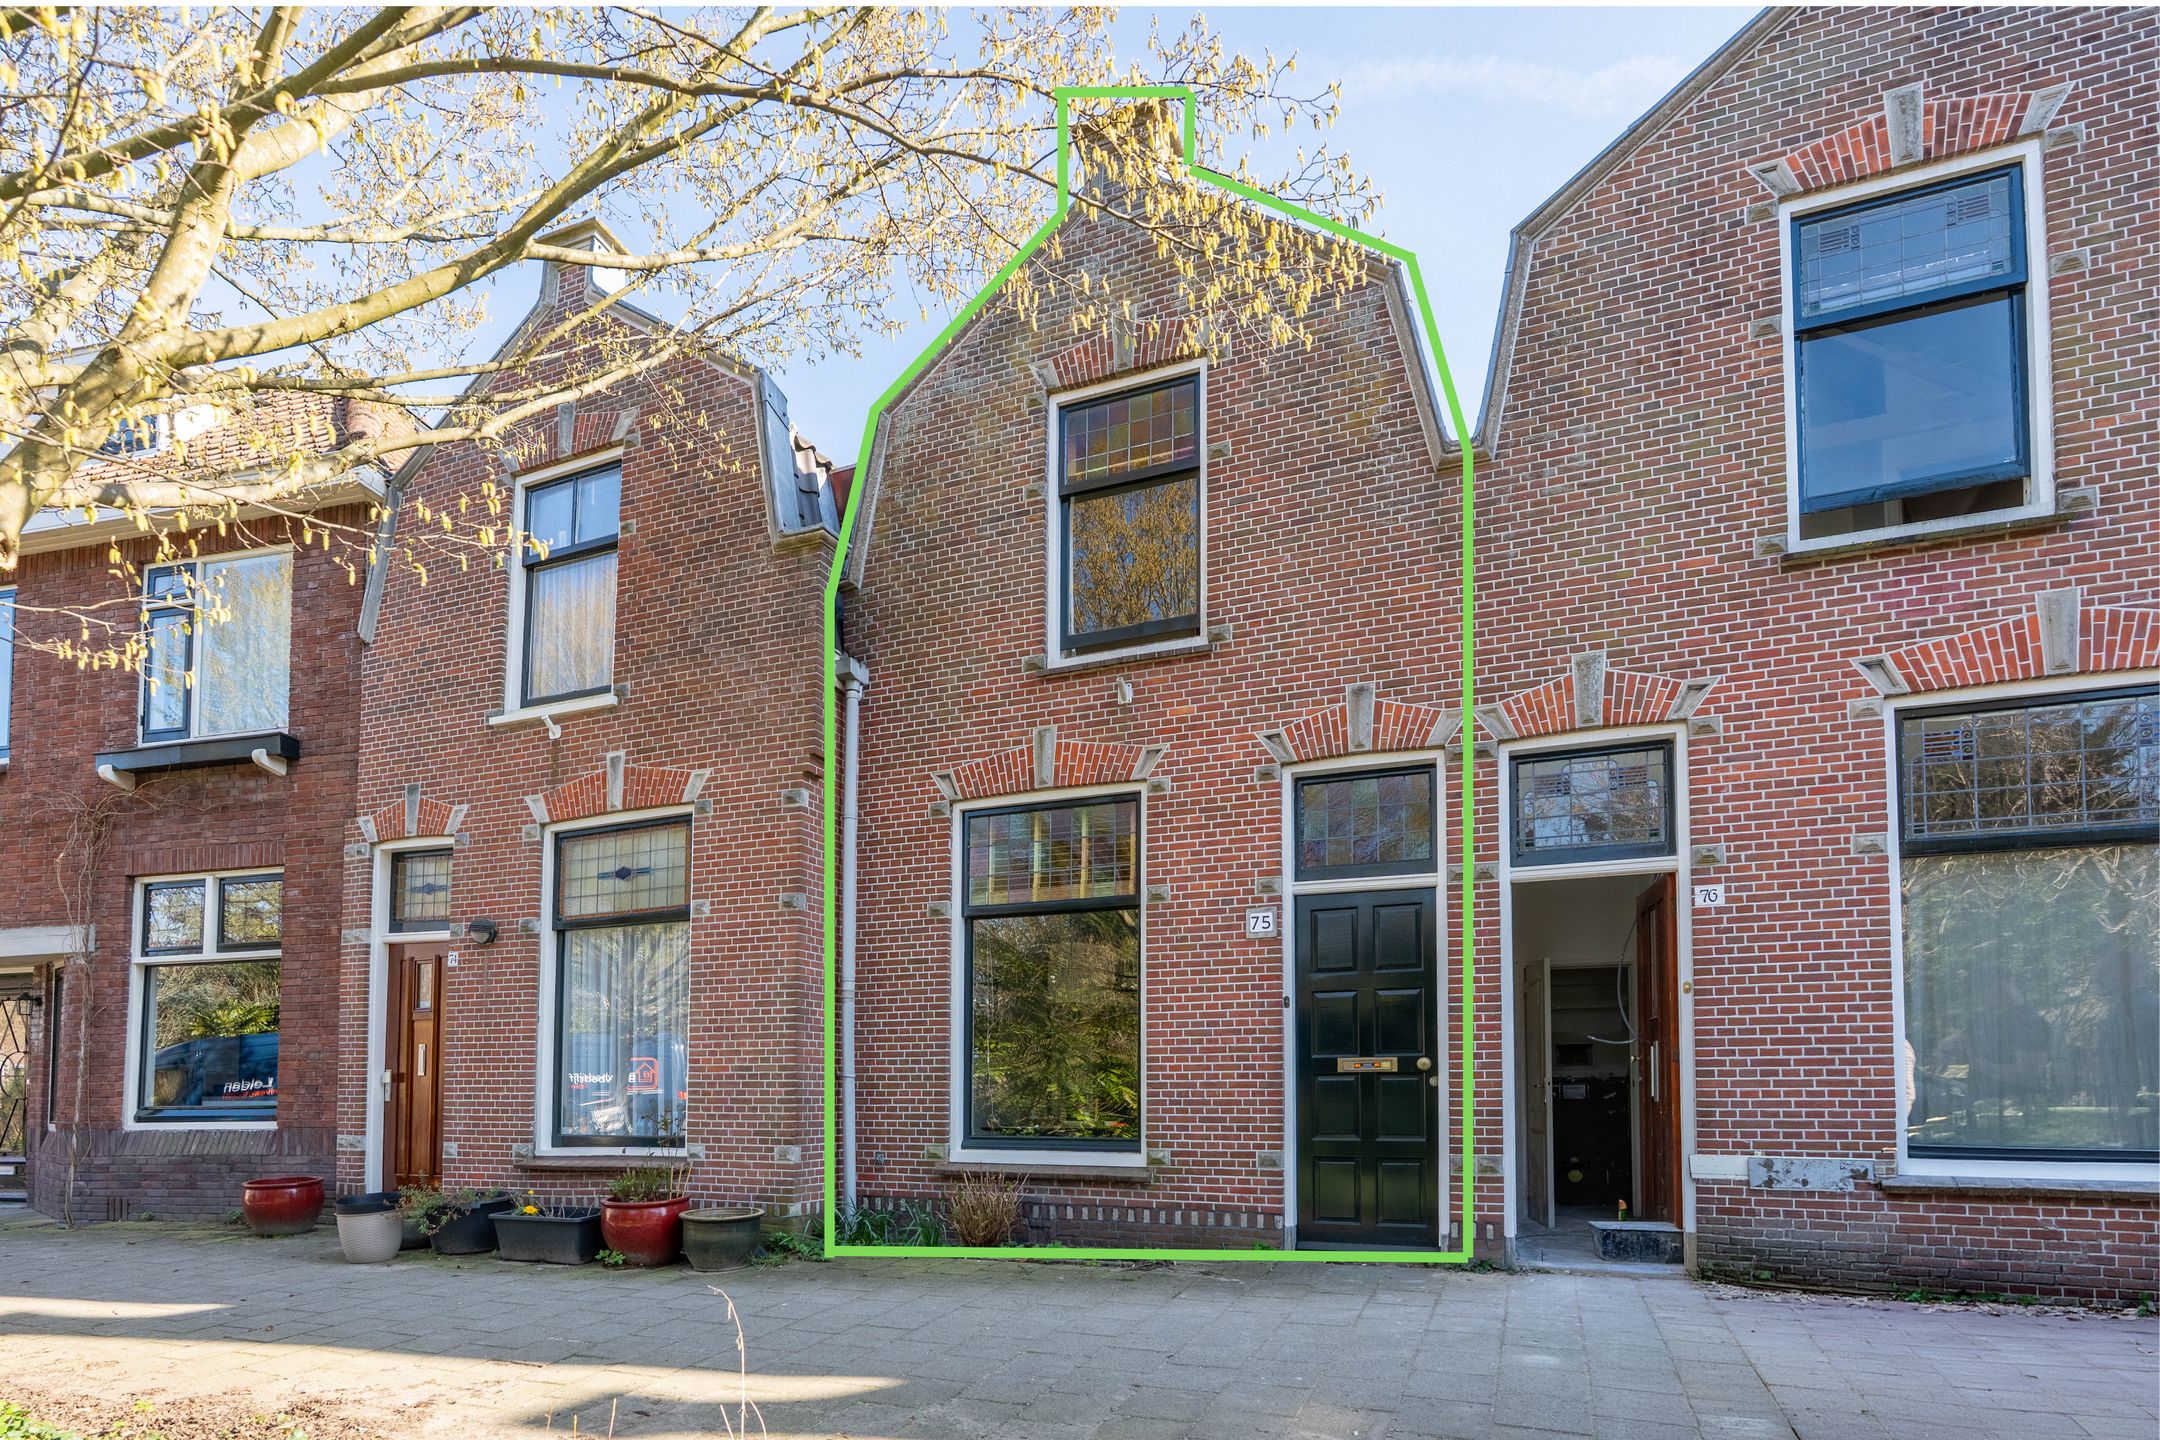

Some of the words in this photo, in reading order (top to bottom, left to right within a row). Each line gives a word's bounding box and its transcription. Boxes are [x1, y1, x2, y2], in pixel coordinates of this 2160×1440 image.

[1700, 889, 1719, 903] 76
[1251, 915, 1271, 930] 75
[449, 954, 457, 964] 74
